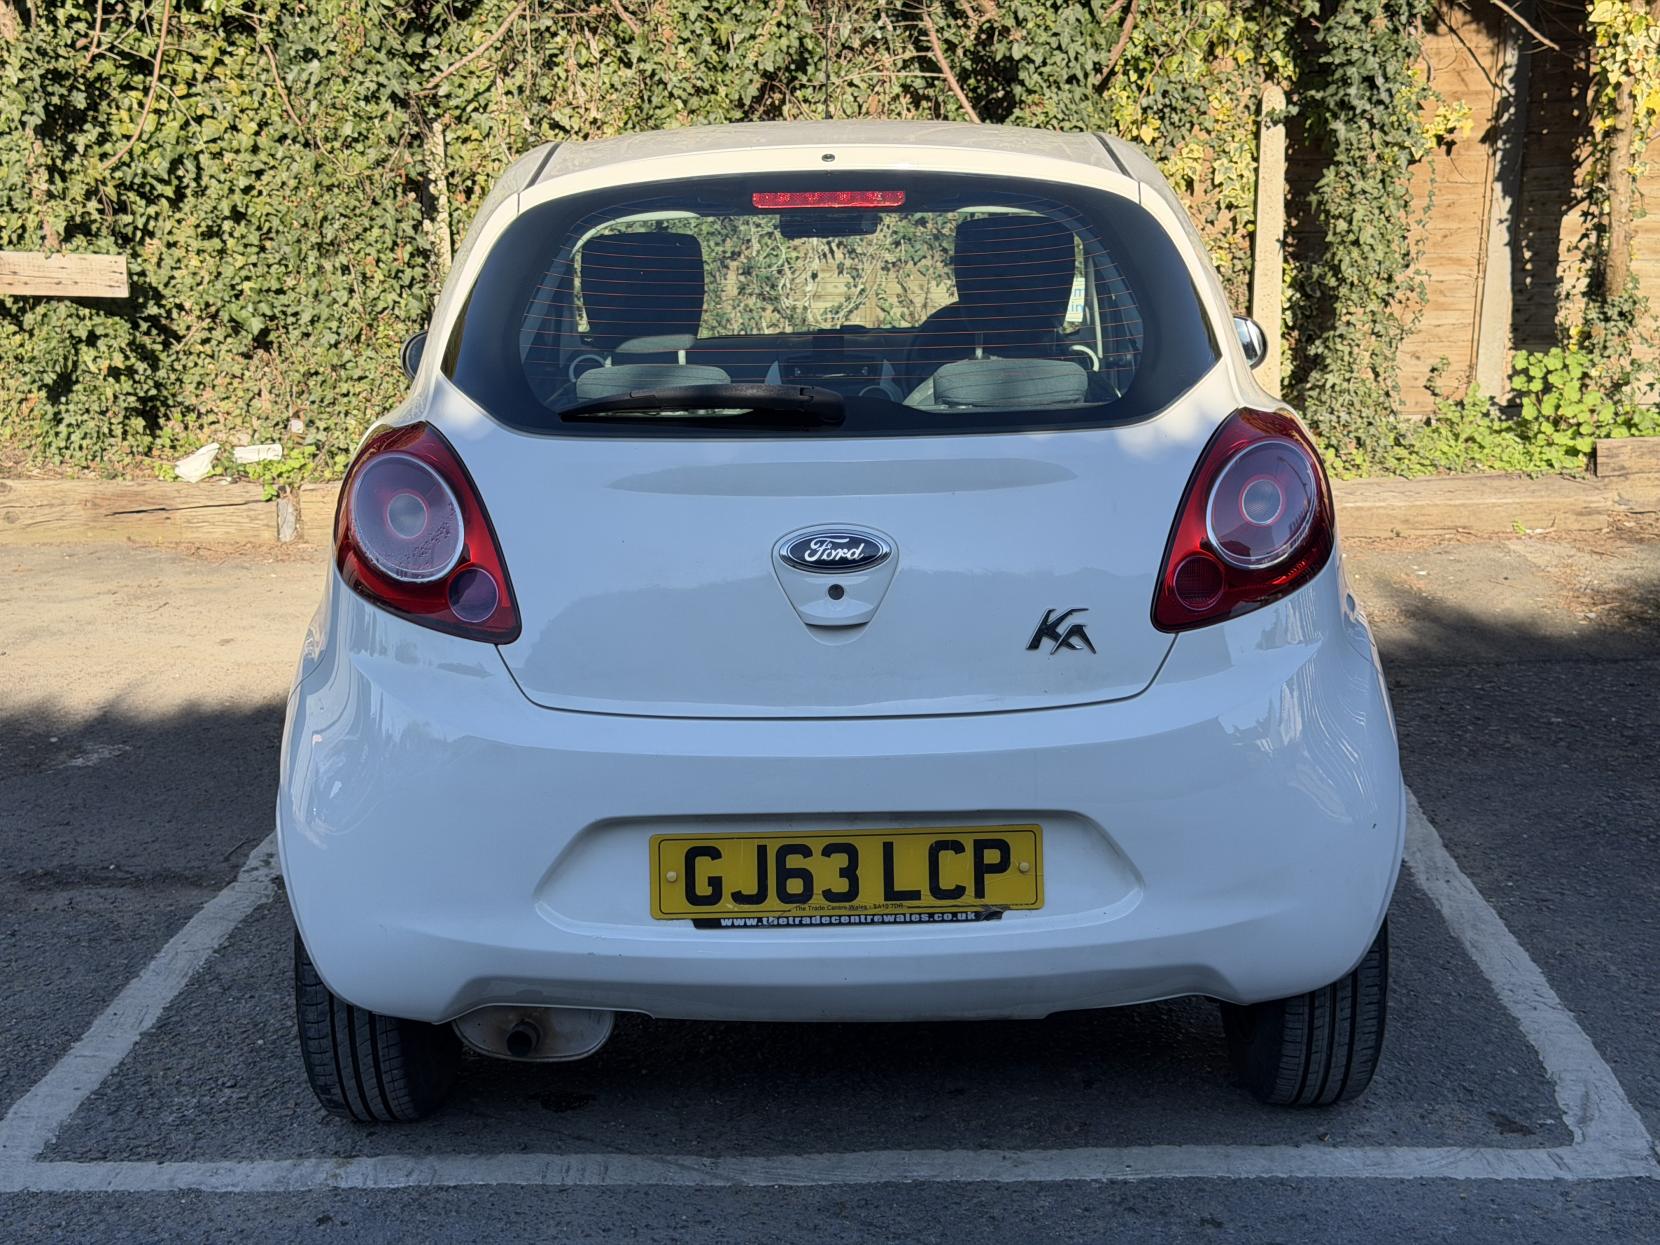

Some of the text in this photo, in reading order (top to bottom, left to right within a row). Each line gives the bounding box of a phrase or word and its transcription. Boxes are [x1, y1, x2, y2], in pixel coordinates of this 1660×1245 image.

[804, 537, 866, 562] Ford
[684, 838, 1011, 906] GJ63 LCP
[720, 911, 976, 927] www.thetradecentrewales.co.uk
